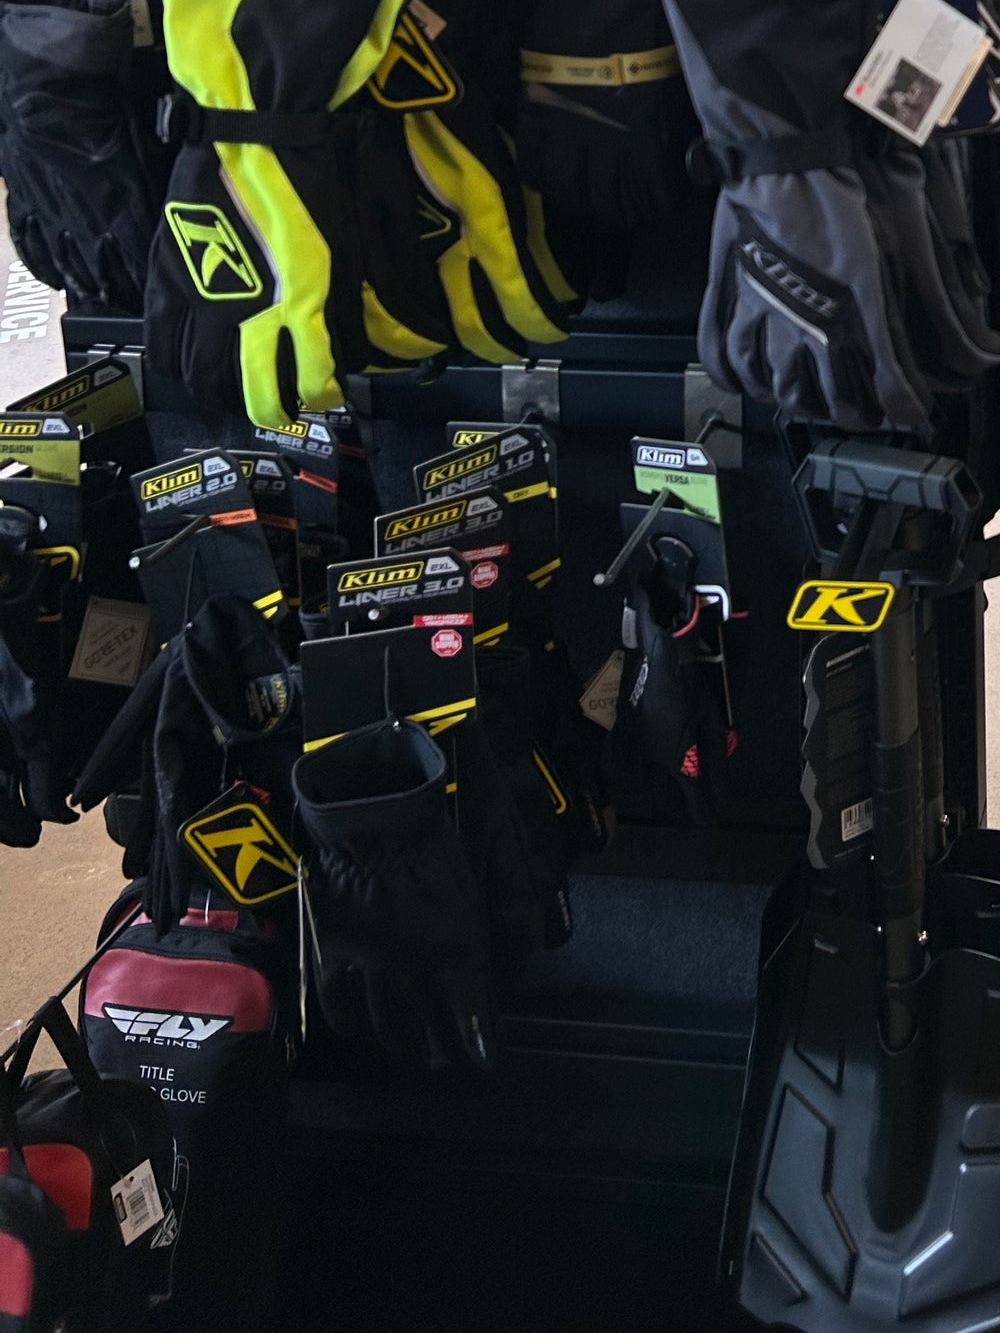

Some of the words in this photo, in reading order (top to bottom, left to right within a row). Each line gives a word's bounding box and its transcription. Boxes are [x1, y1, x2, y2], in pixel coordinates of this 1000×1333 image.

[0, 423, 37, 434] lim
[429, 451, 492, 485] Klim
[641, 448, 682, 465] Klim
[145, 470, 198, 496] Klim
[146, 484, 203, 512] LINER
[206, 472, 238, 491] 2.0
[390, 507, 460, 536] Klim
[385, 525, 460, 554] LINER
[344, 567, 417, 588] Klim
[338, 584, 418, 608] LINER
[423, 576, 465, 594] 3.0
[104, 1006, 230, 1042] FLY
[124, 1035, 200, 1049] RACING
[139, 1065, 175, 1082] TITLE
[160, 1087, 206, 1104] GLOVE
